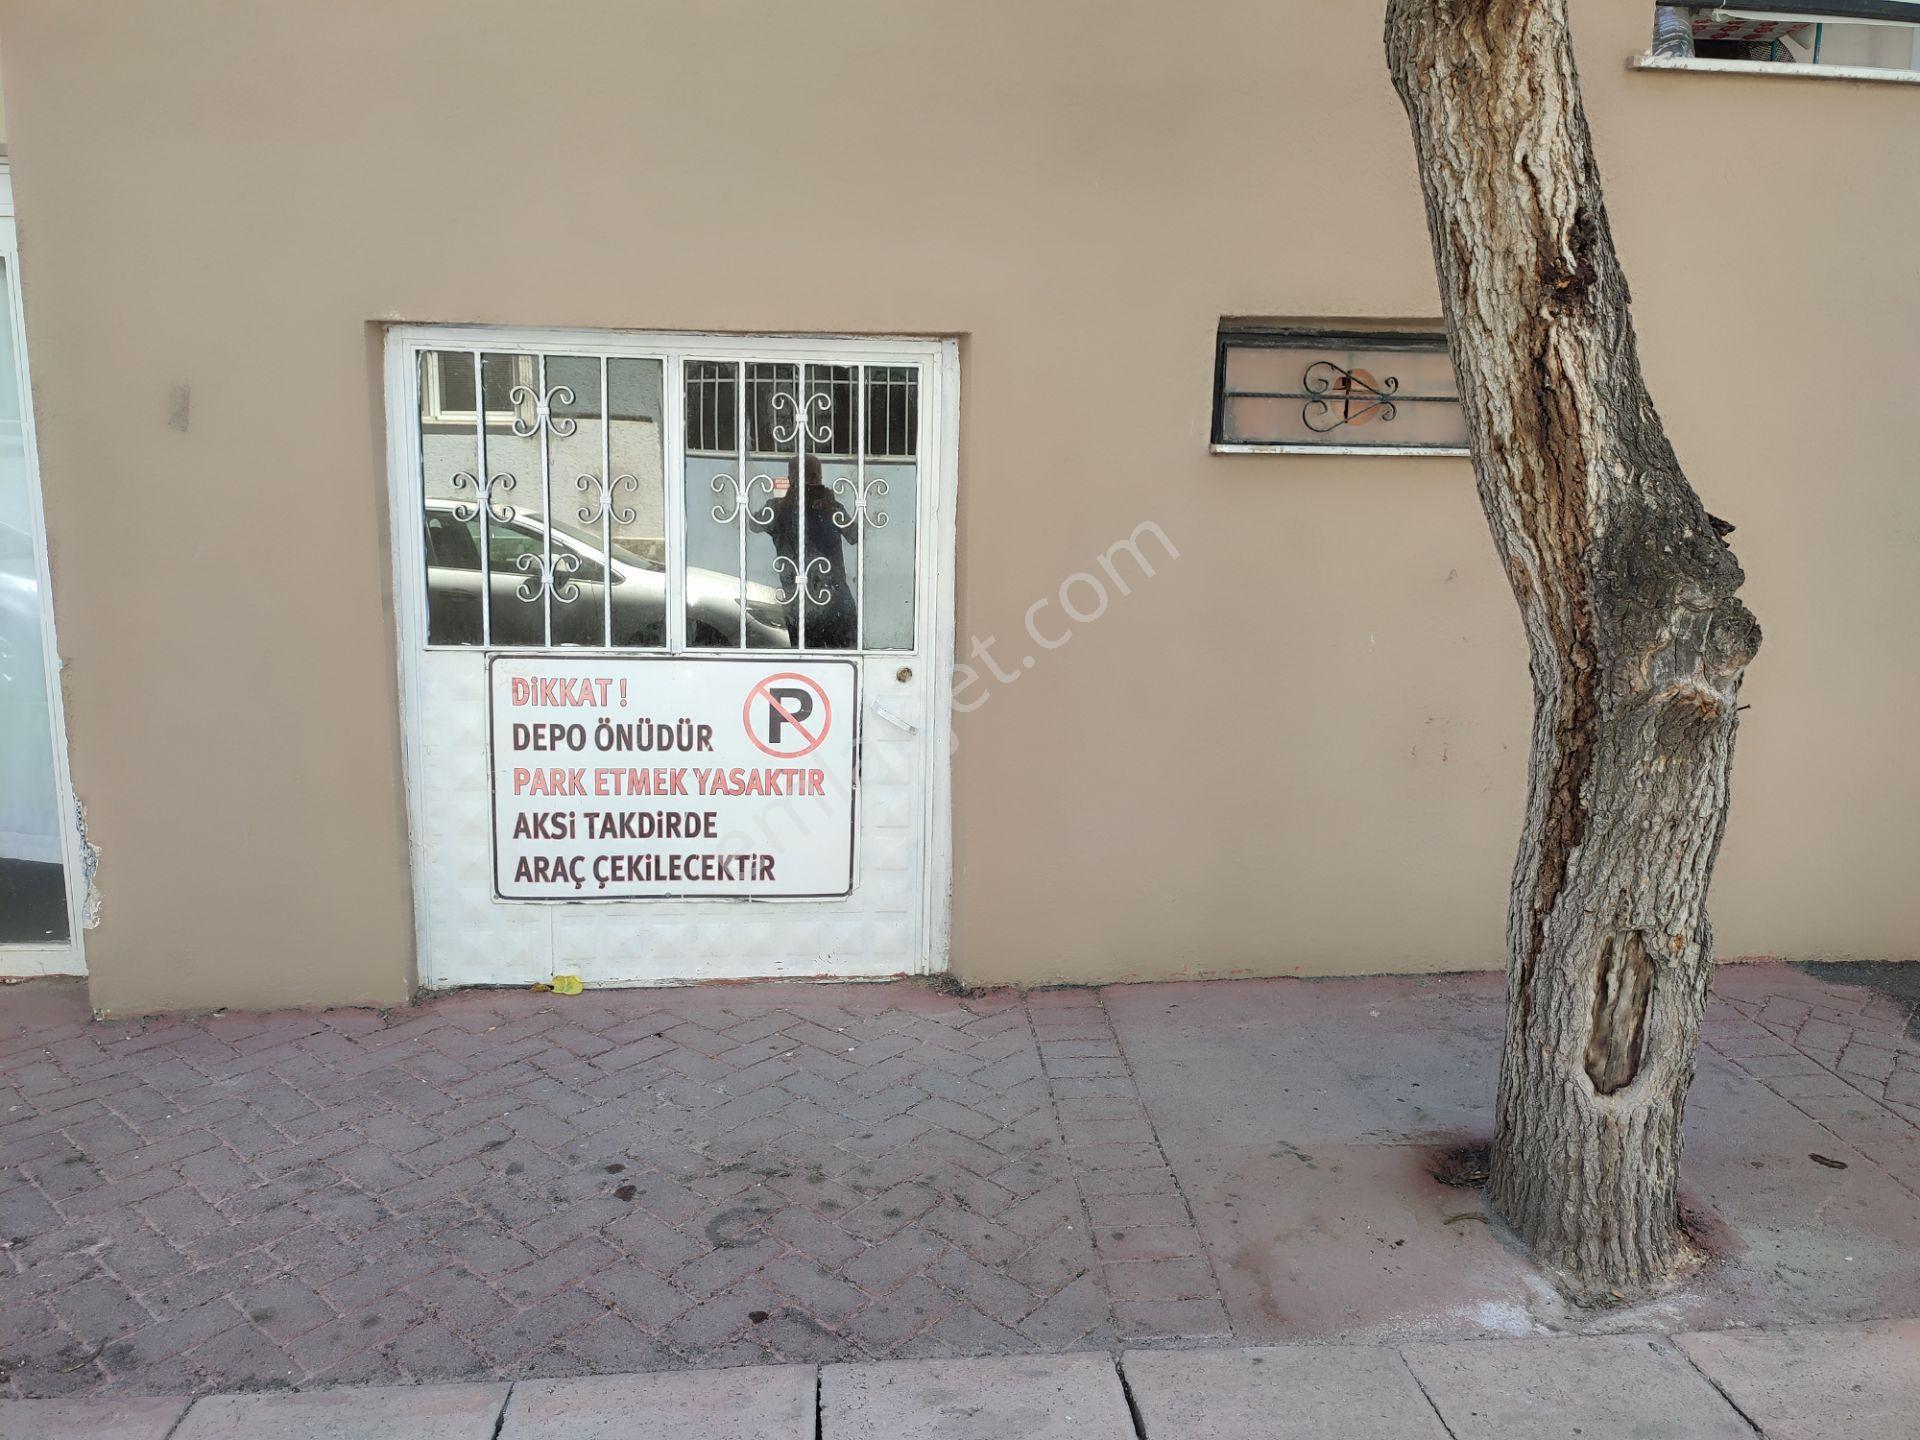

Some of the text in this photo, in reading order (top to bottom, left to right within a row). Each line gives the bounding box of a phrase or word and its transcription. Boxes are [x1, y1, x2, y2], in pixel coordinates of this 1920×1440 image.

[769, 687, 813, 744] P
[512, 717, 714, 752] DEPO ÖNÜDÜR
[513, 768, 826, 797] PARK ETMEK YASAKTIR
[514, 855, 587, 889] ARAÇ
